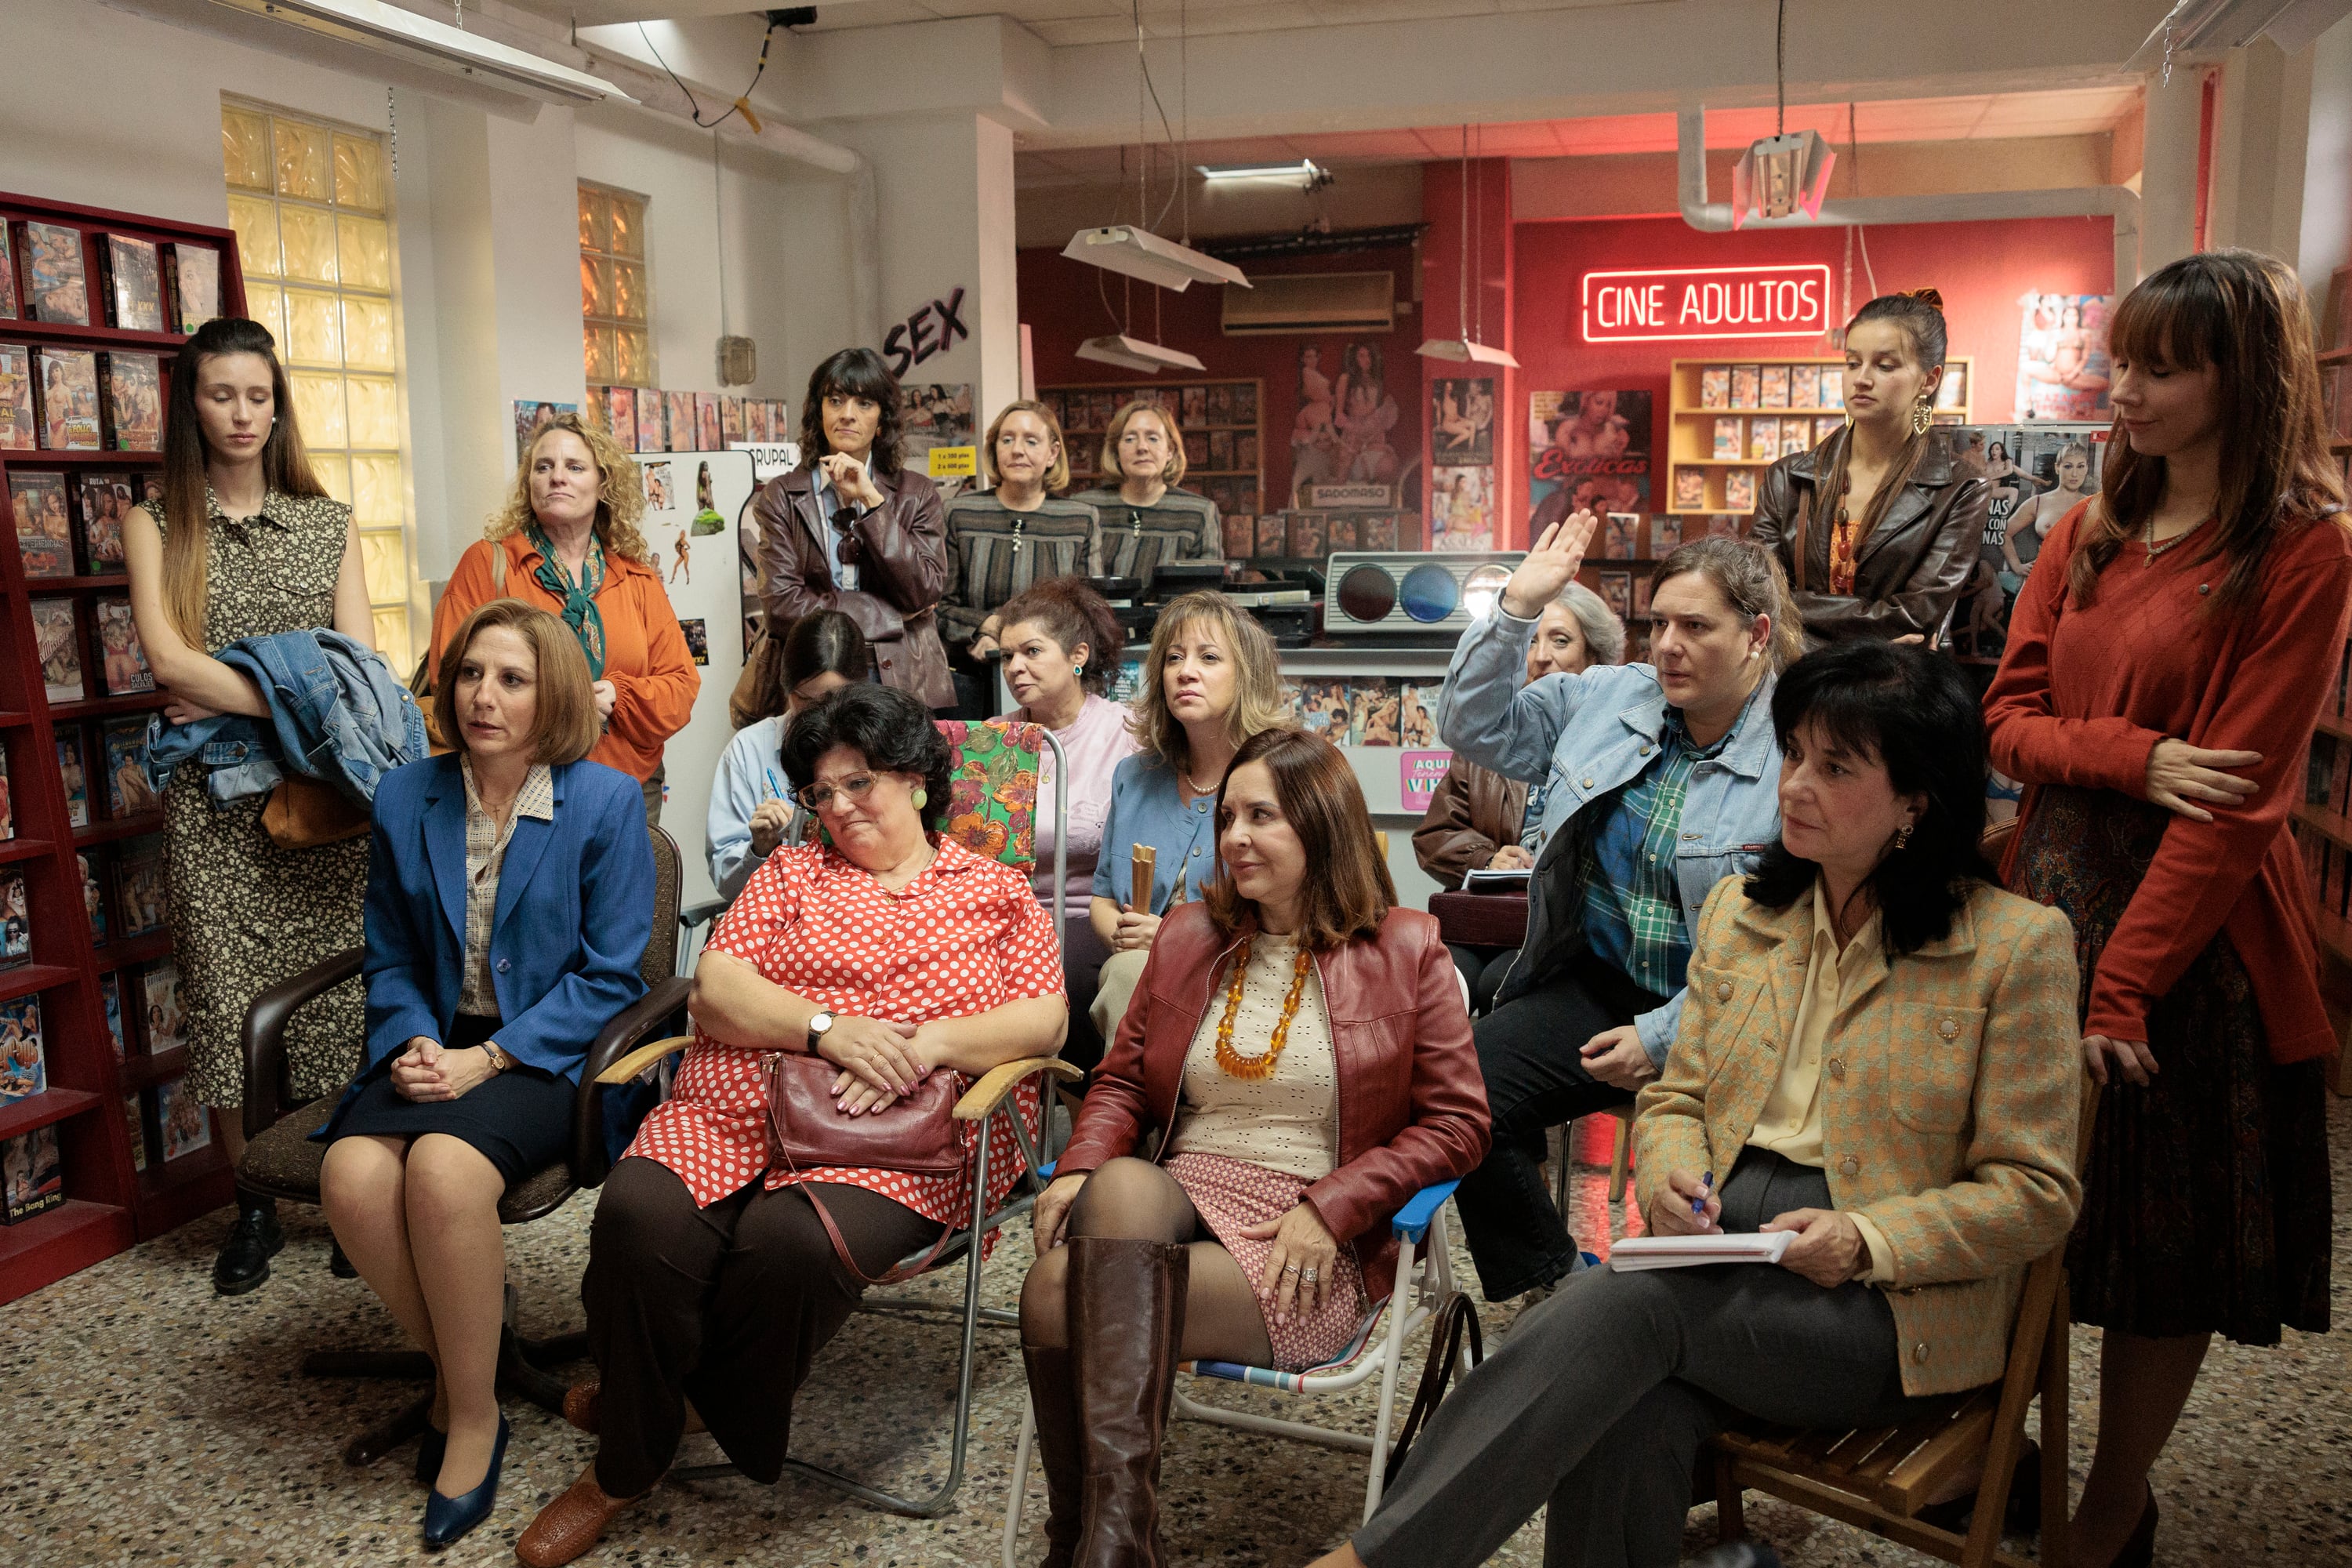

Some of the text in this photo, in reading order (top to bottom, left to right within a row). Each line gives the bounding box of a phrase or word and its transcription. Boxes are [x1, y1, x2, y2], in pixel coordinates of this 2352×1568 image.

[1598, 280, 1818, 328] CINE ADULTOS
[884, 288, 967, 379] SEX
[0, 408, 16, 417] AL
[1317, 488, 1385, 499] SADOMASO
[1989, 499, 2009, 515] NAS
[1989, 519, 2007, 531] CON
[1983, 532, 2005, 545] NAS
[130, 672, 153, 684] CULOS
[131, 681, 154, 690] SALVAJES
[1406, 779, 1441, 792] VH
[9, 1192, 62, 1218] The Bang Ring
